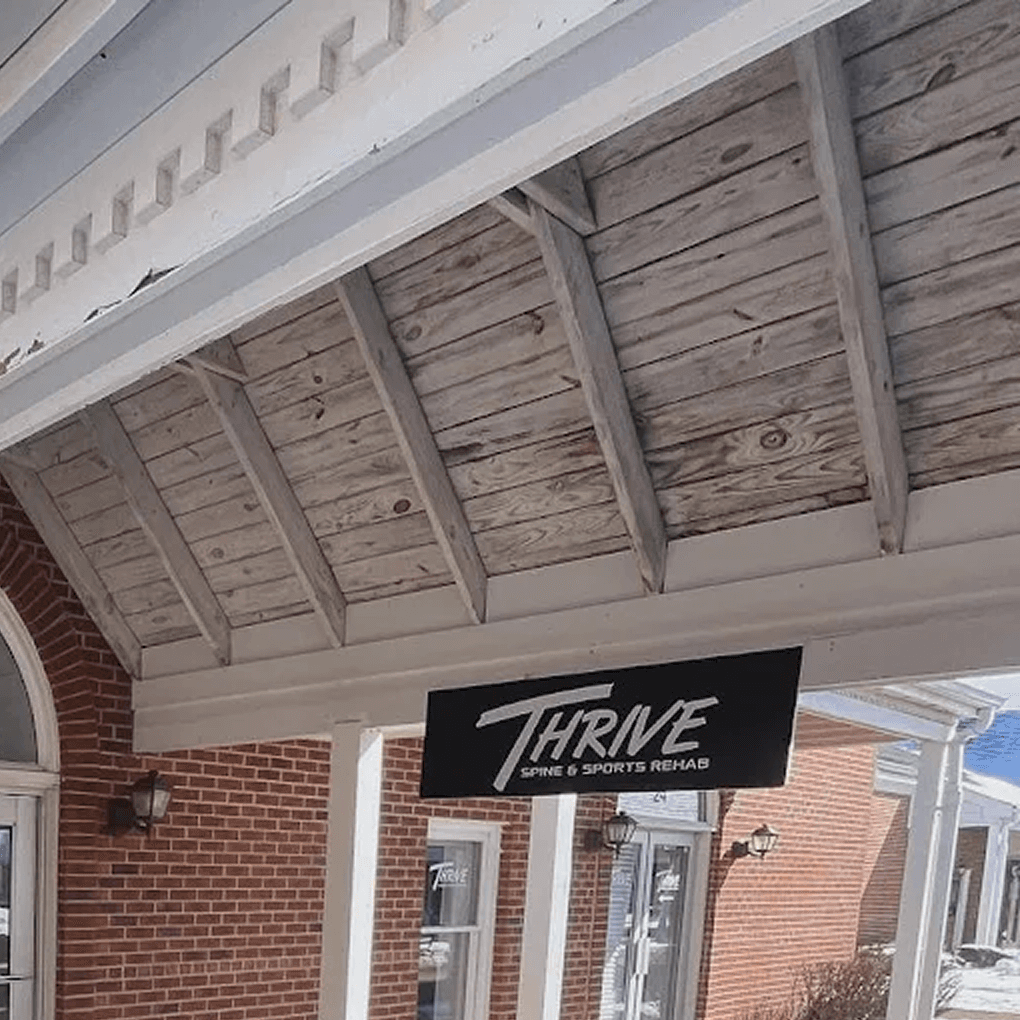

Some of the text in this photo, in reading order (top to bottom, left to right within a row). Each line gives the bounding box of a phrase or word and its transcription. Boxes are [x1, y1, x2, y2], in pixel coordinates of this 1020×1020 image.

[475, 682, 719, 792] THRIVE
[520, 757, 710, 779] SPINE & SPORTS REHAB
